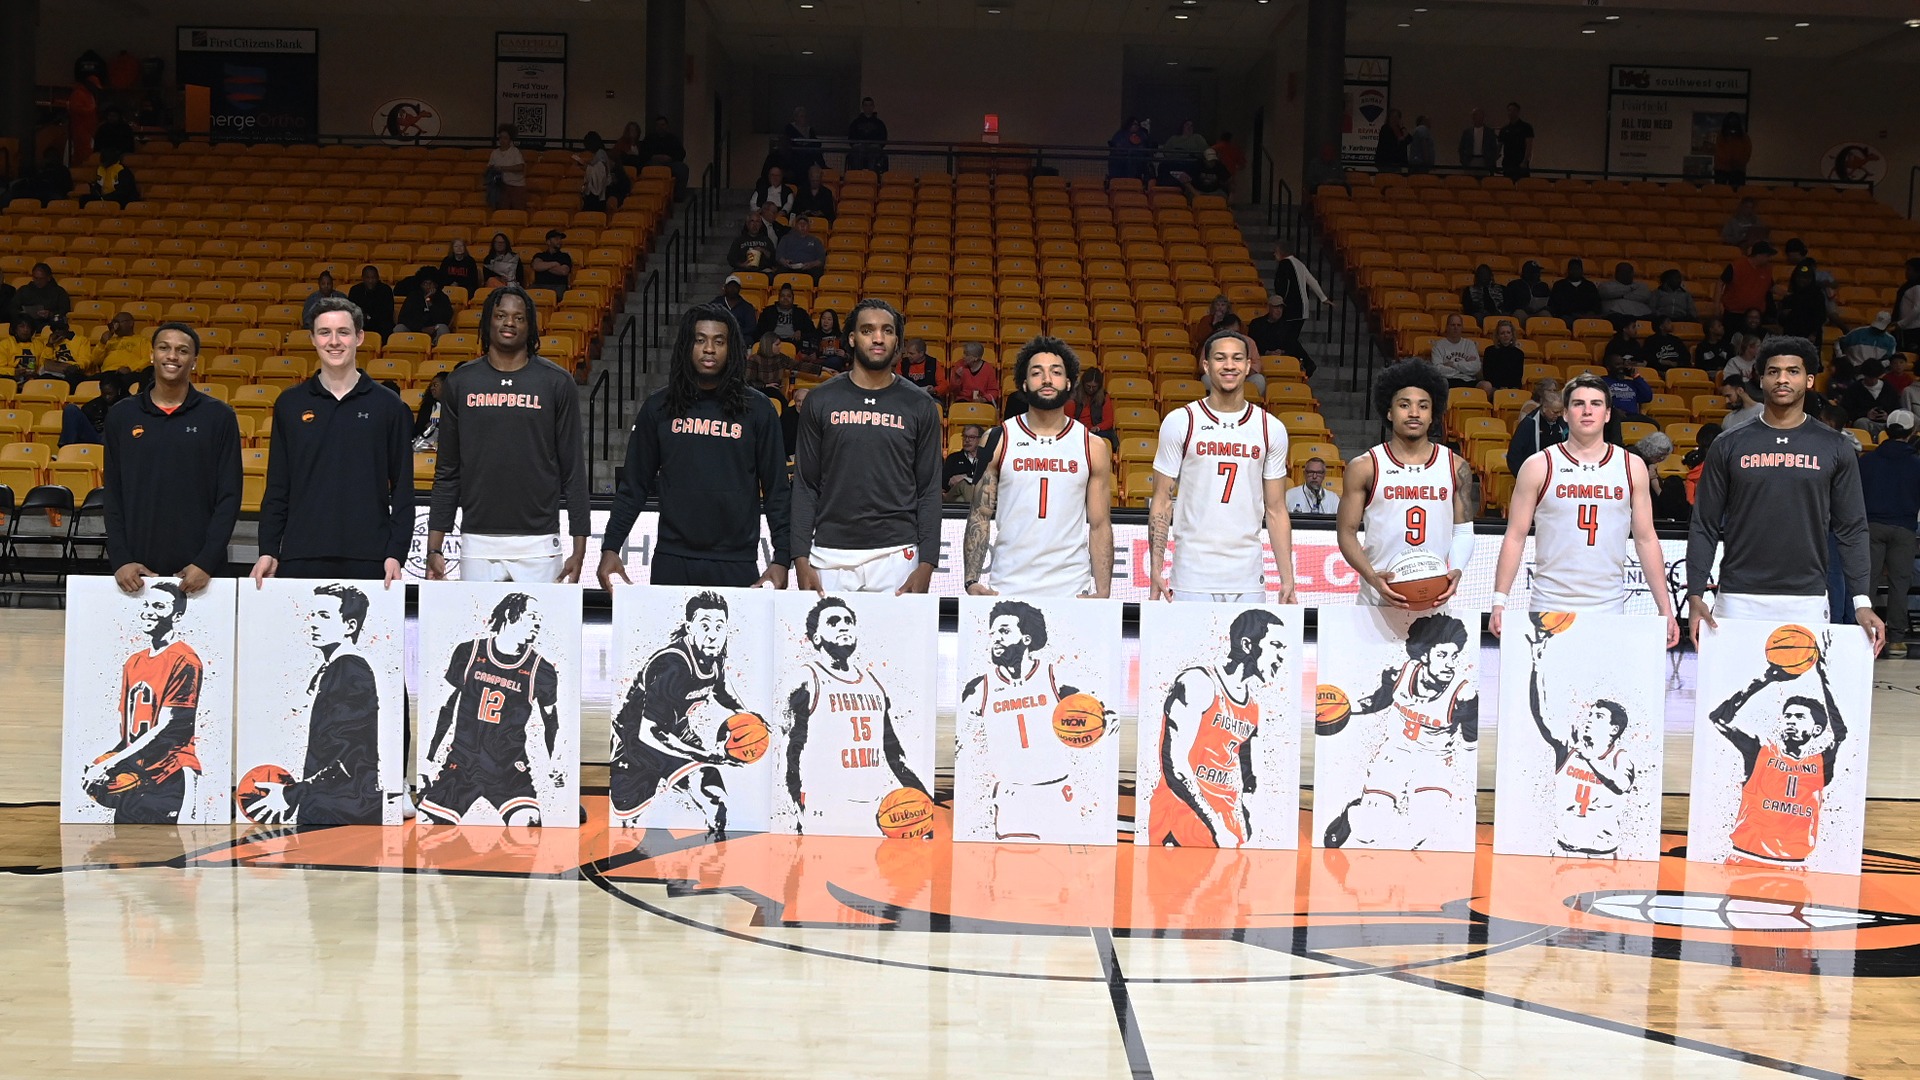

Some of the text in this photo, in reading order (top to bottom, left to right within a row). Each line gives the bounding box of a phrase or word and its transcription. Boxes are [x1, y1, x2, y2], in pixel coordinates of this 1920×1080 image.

[512, 82, 529, 90] Find
[1656, 78, 1711, 88] southwest
[1716, 80, 1738, 89] grill
[542, 92, 559, 100] Here
[1621, 118, 1673, 130] ALL YOU NEED
[1621, 131, 1651, 141] IS HERE!
[466, 393, 542, 409] CAMPBELL
[671, 417, 743, 440] CAMELS
[830, 410, 905, 430] CAMPBELL
[1196, 441, 1261, 460] CAMELS
[1013, 457, 1078, 474] CAMELS
[1740, 453, 1821, 470] CAMPBELL
[1217, 462, 1239, 504] 7
[1383, 485, 1448, 501] CAMELS
[1555, 483, 1624, 500] CAMELS
[1038, 477, 1049, 519] 1
[1405, 505, 1427, 547] 9
[1577, 504, 1599, 546] 4
[474, 670, 522, 692] CAMPBELL
[477, 686, 506, 725] 12
[828, 692, 883, 713] FIGHTING
[850, 716, 872, 742] 15
[1016, 713, 1029, 749] 1
[1212, 712, 1255, 737] FIGHTIN
[1227, 740, 1238, 765] 7
[1195, 765, 1232, 785] CAM
[1566, 765, 1603, 785] CAMEL
[1786, 775, 1798, 797] 11
[1575, 784, 1591, 816] 4
[1762, 799, 1813, 818] CAMELS
[888, 808, 927, 824] Wilson
